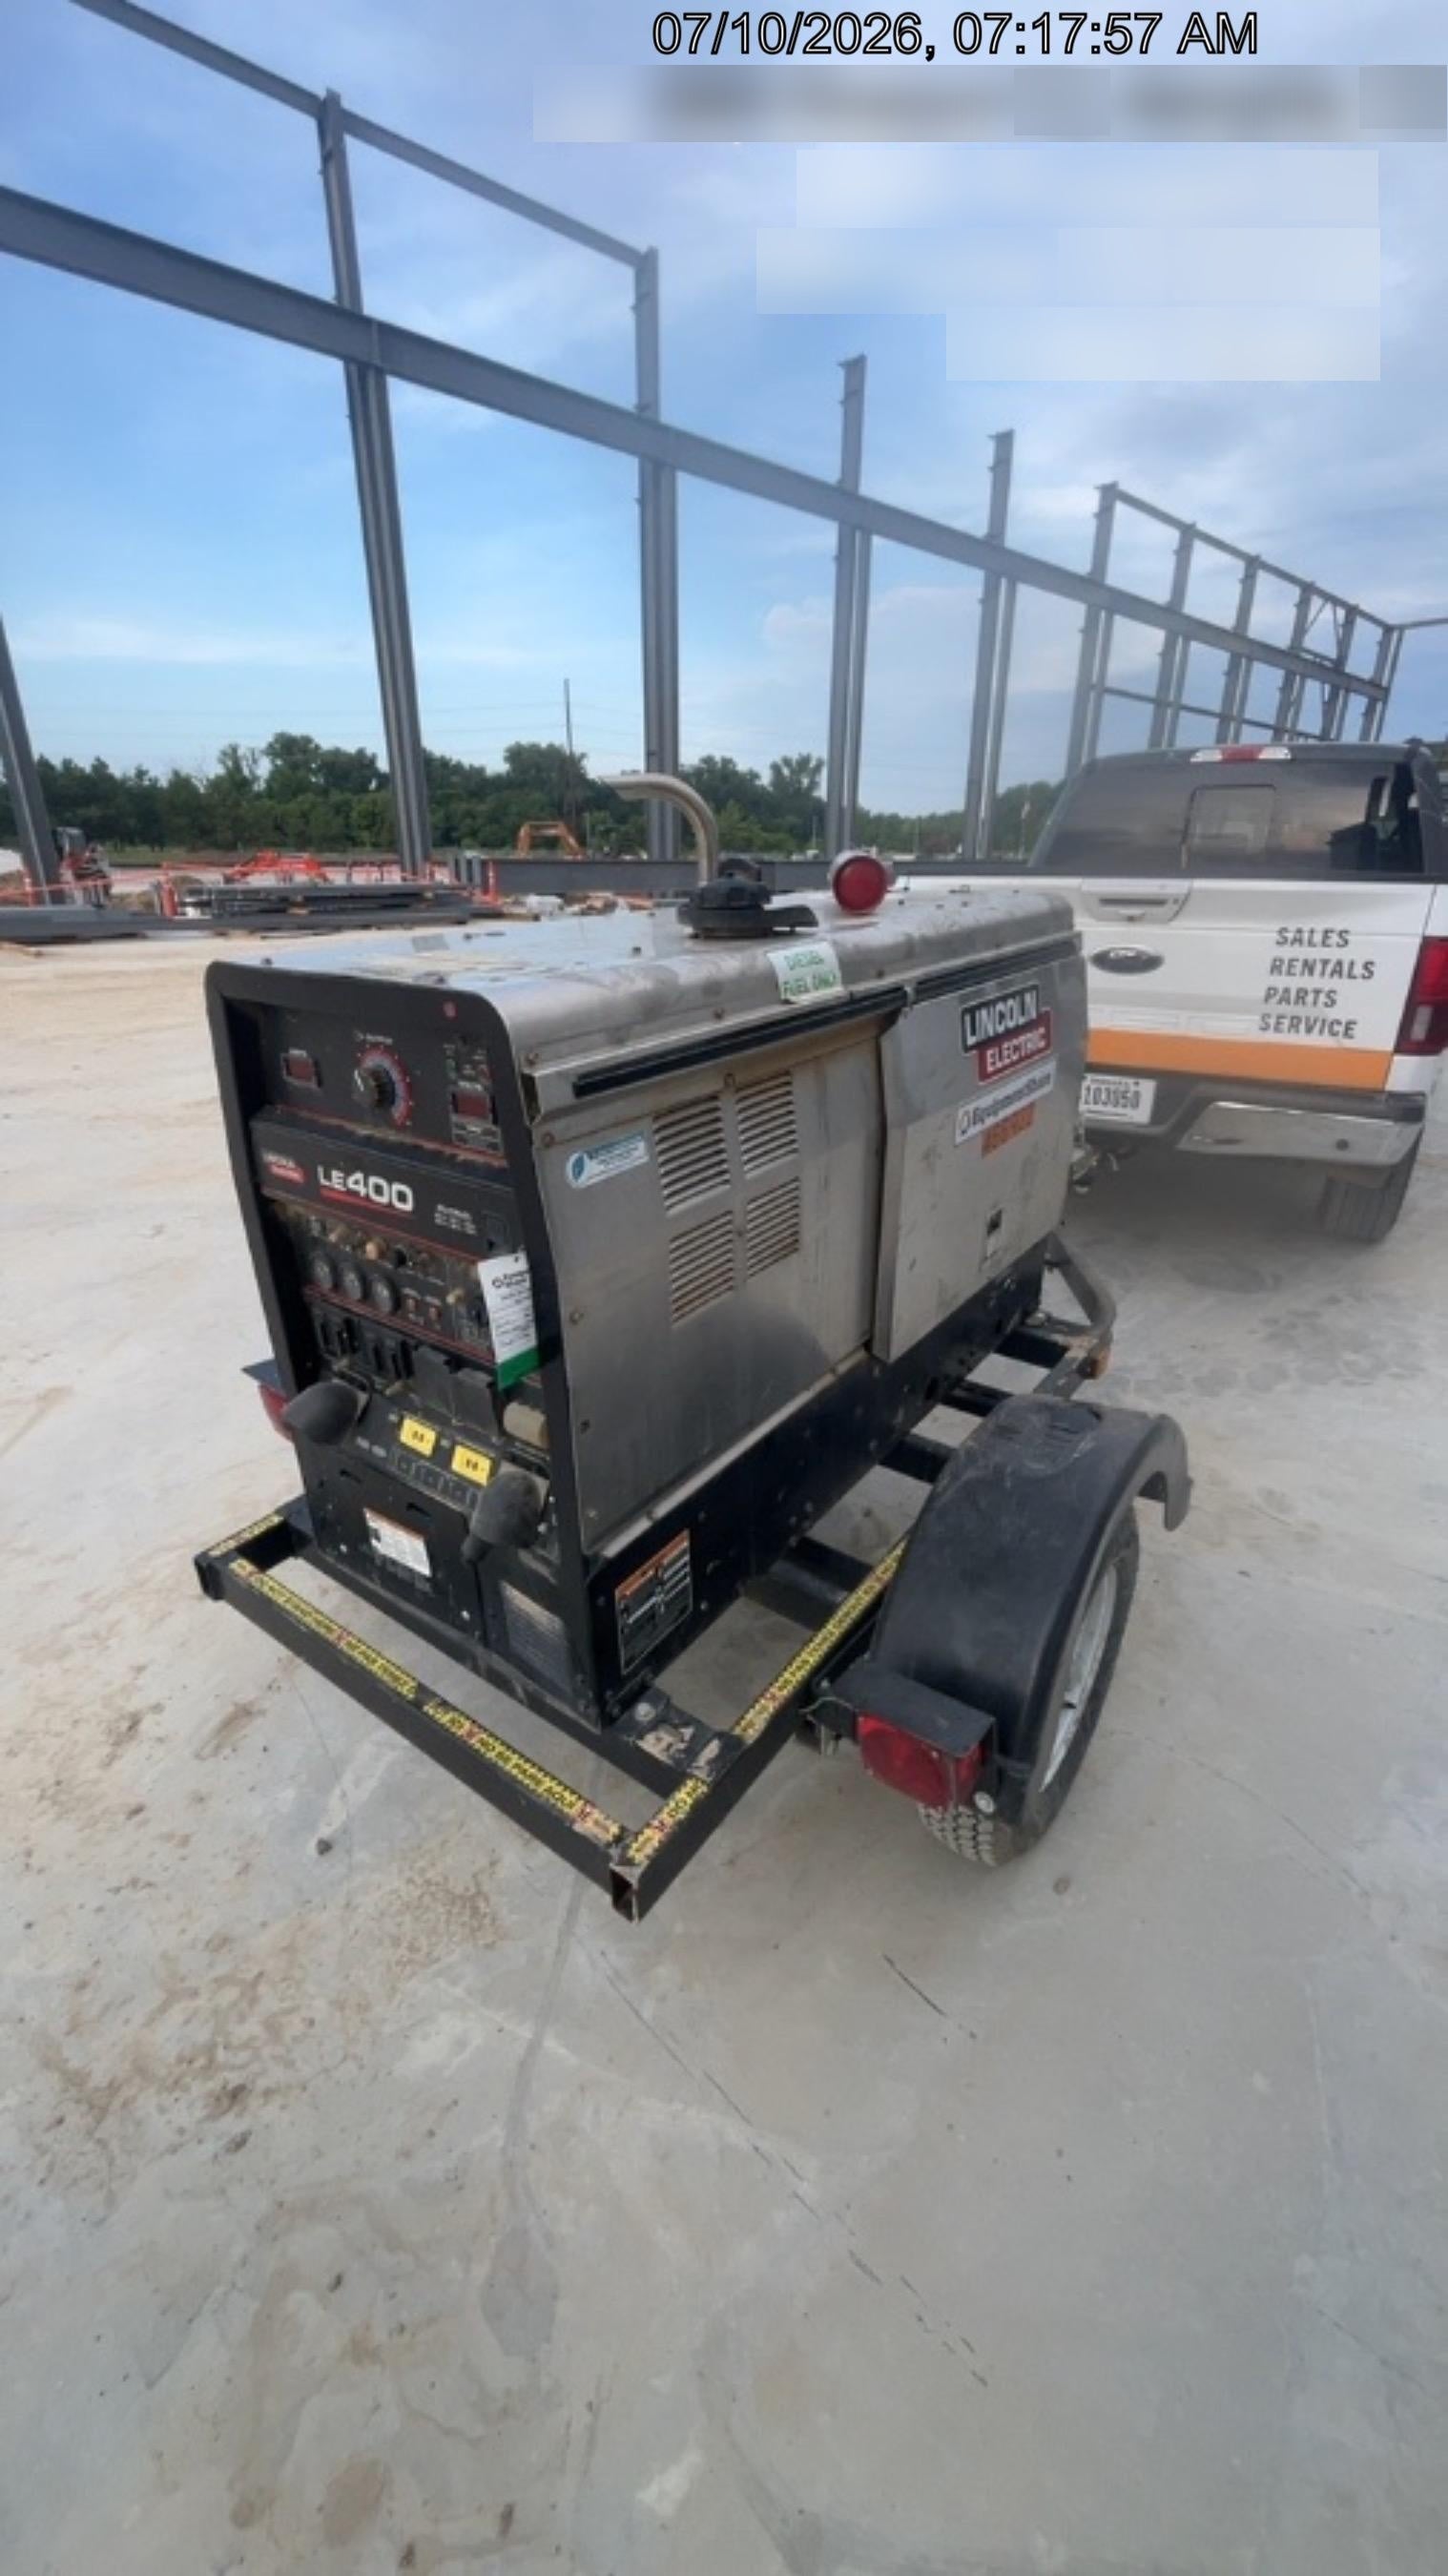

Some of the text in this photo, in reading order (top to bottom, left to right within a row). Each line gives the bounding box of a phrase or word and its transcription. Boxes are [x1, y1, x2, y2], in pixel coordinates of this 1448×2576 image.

[1275, 926, 1350, 948] SALES
[1270, 957, 1376, 981] RENTALS
[1264, 987, 1337, 1008] PARTS
[963, 989, 1038, 1047] LINCOLN
[1259, 1013, 1357, 1039] SERVICE
[985, 1026, 1046, 1073] ELECTRIC
[317, 1164, 415, 1213] LE400
